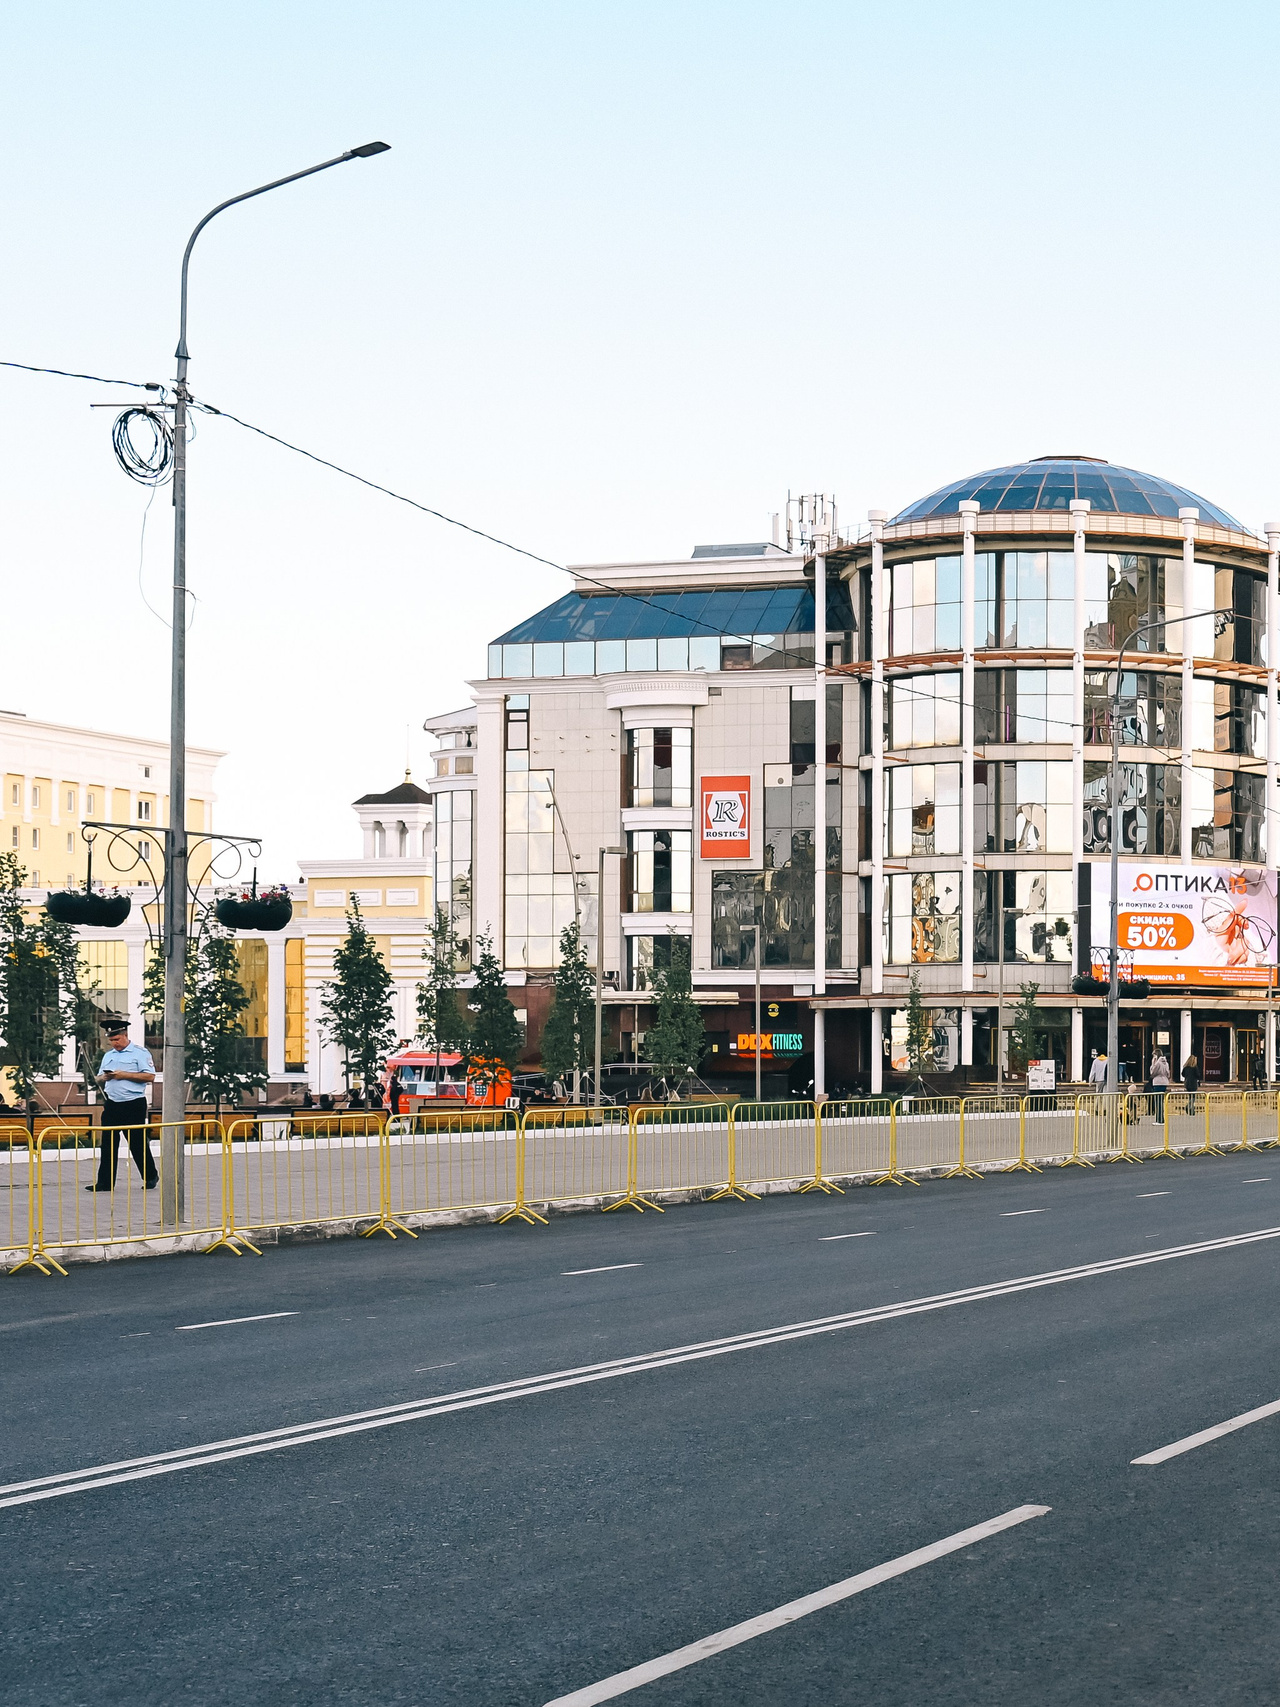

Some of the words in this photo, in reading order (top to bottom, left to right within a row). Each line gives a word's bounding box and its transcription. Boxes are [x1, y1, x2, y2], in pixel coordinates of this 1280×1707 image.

[1130, 916, 1174, 925] скидка
[1127, 926, 1177, 947] 50%
[1176, 973, 1186, 981] 35
[738, 1034, 772, 1050] DDX
[772, 1034, 803, 1050] FITNESS
